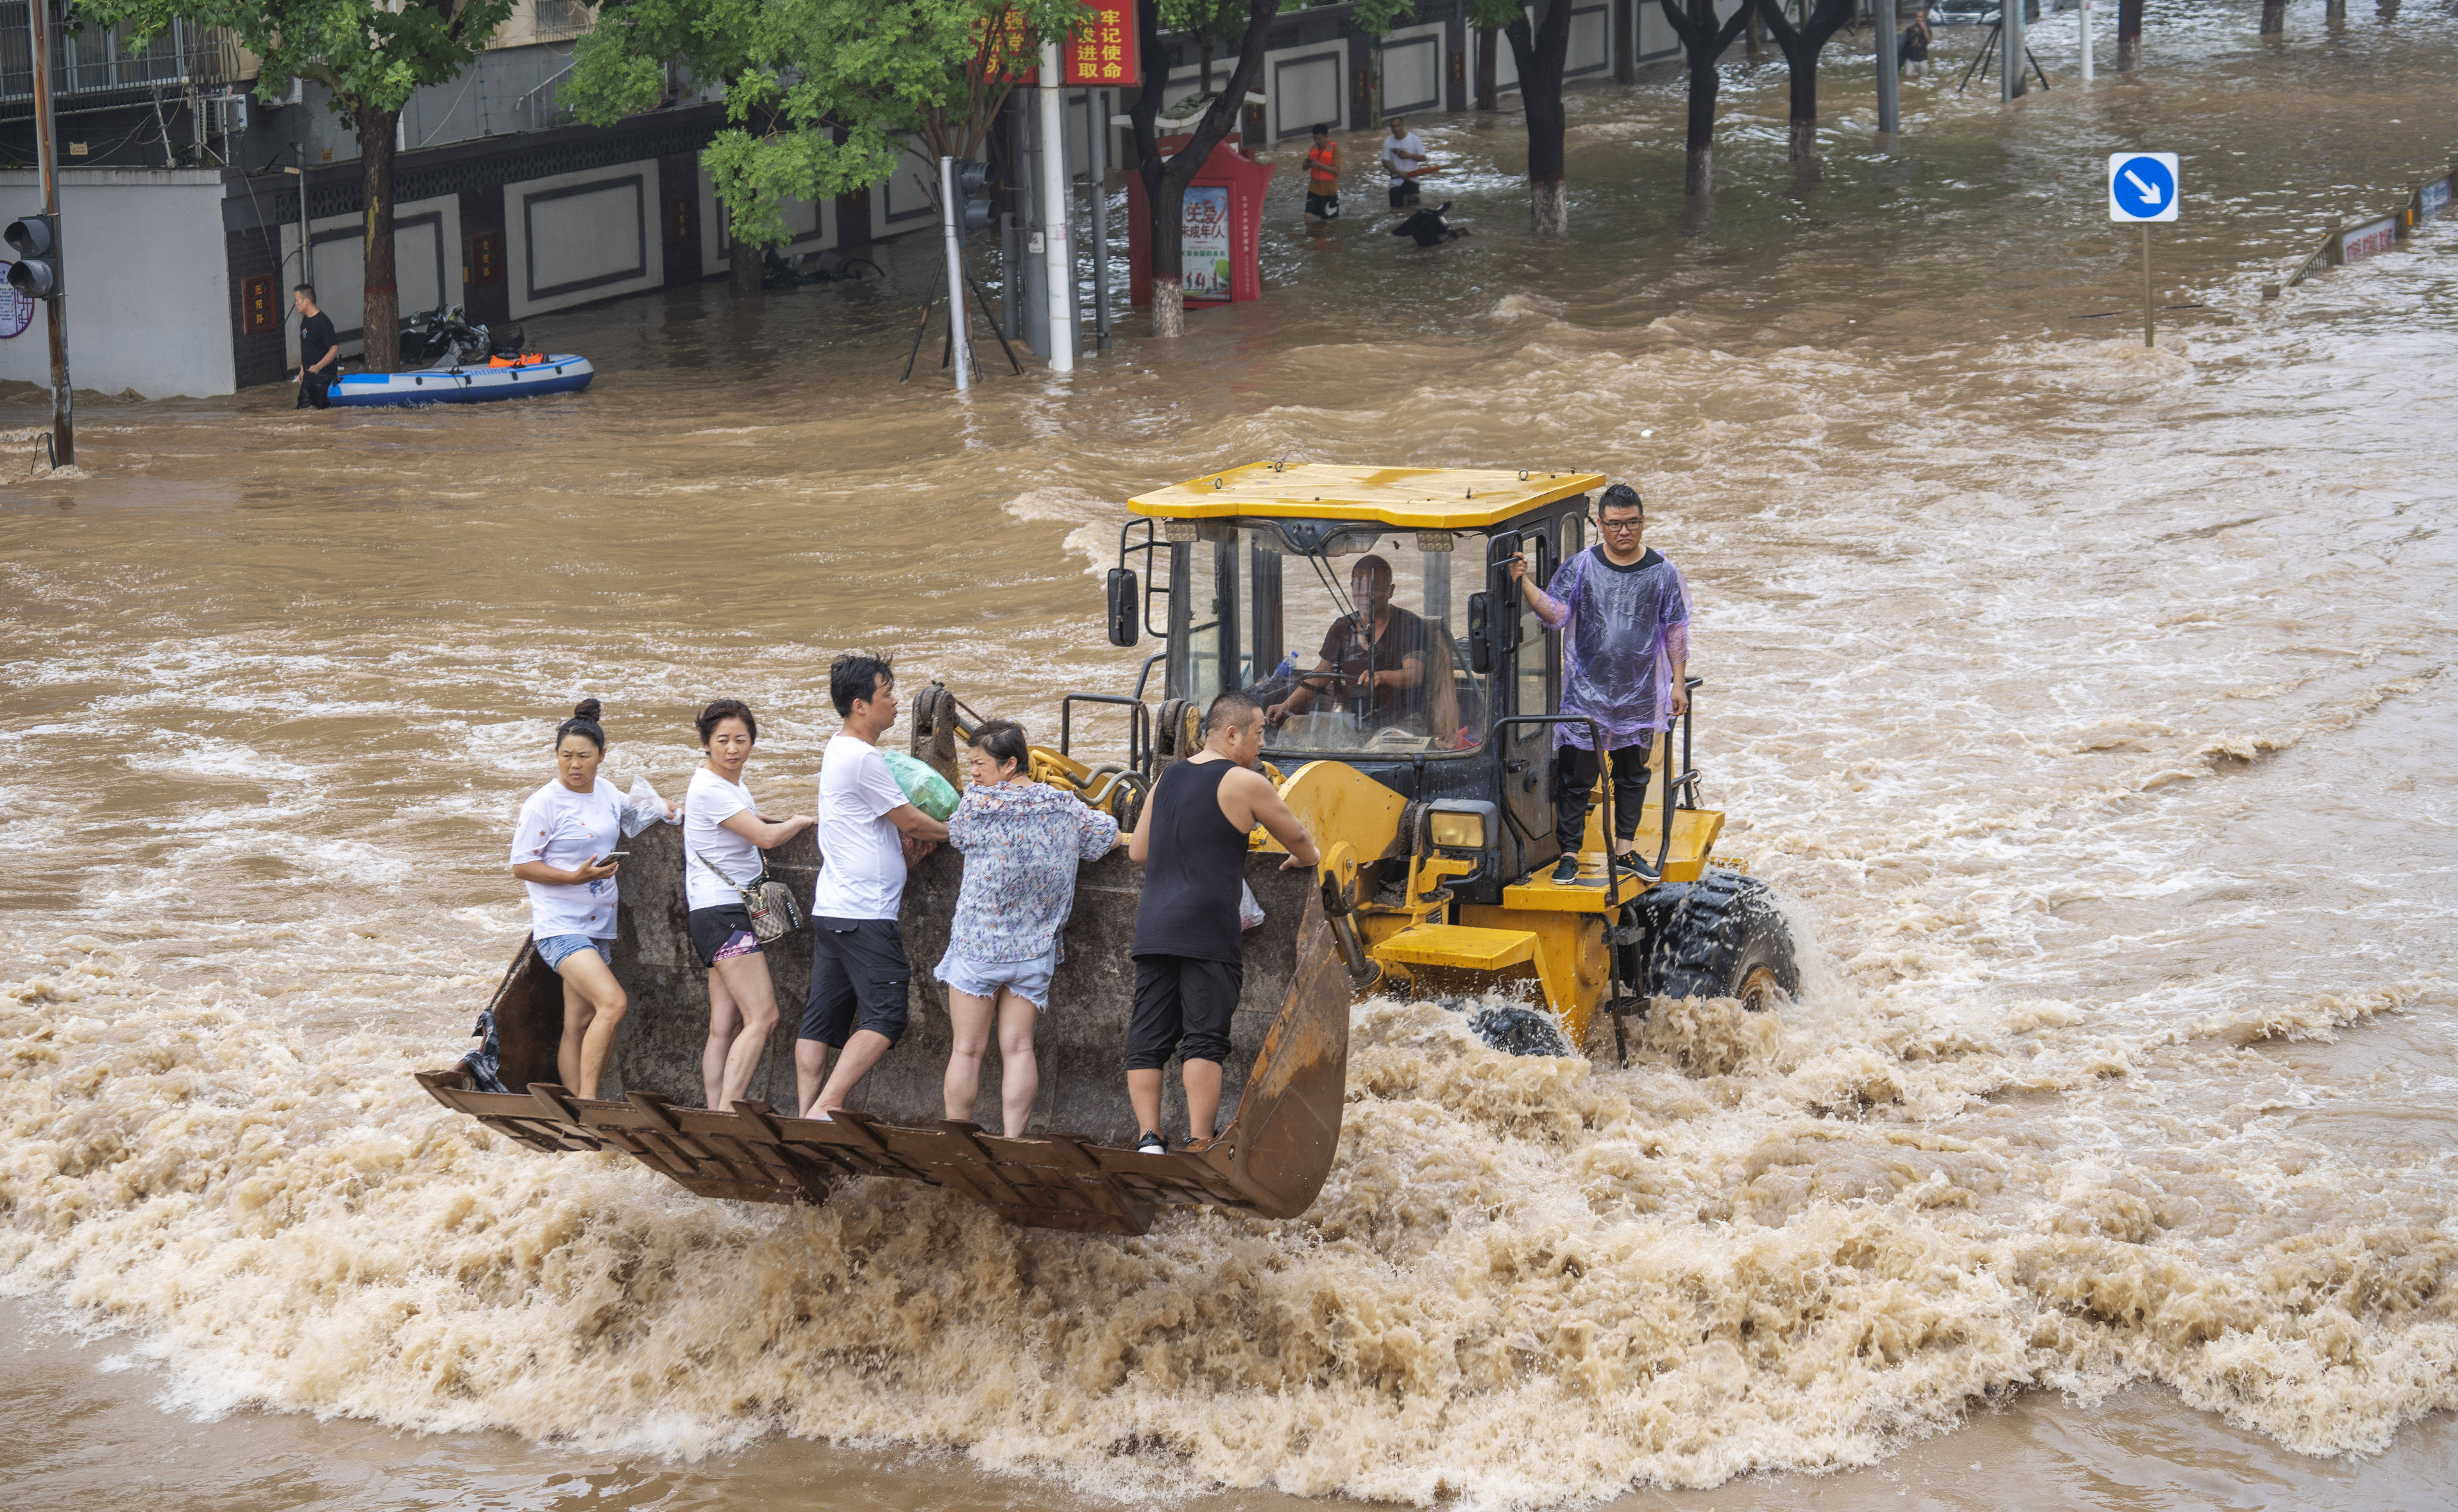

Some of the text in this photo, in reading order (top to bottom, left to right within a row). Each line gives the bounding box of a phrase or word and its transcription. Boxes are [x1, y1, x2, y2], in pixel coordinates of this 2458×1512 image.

[1100, 9, 1123, 78] 牢记使命
[1184, 199, 1218, 224] 关爱
[1182, 224, 1225, 238] 未成年人
